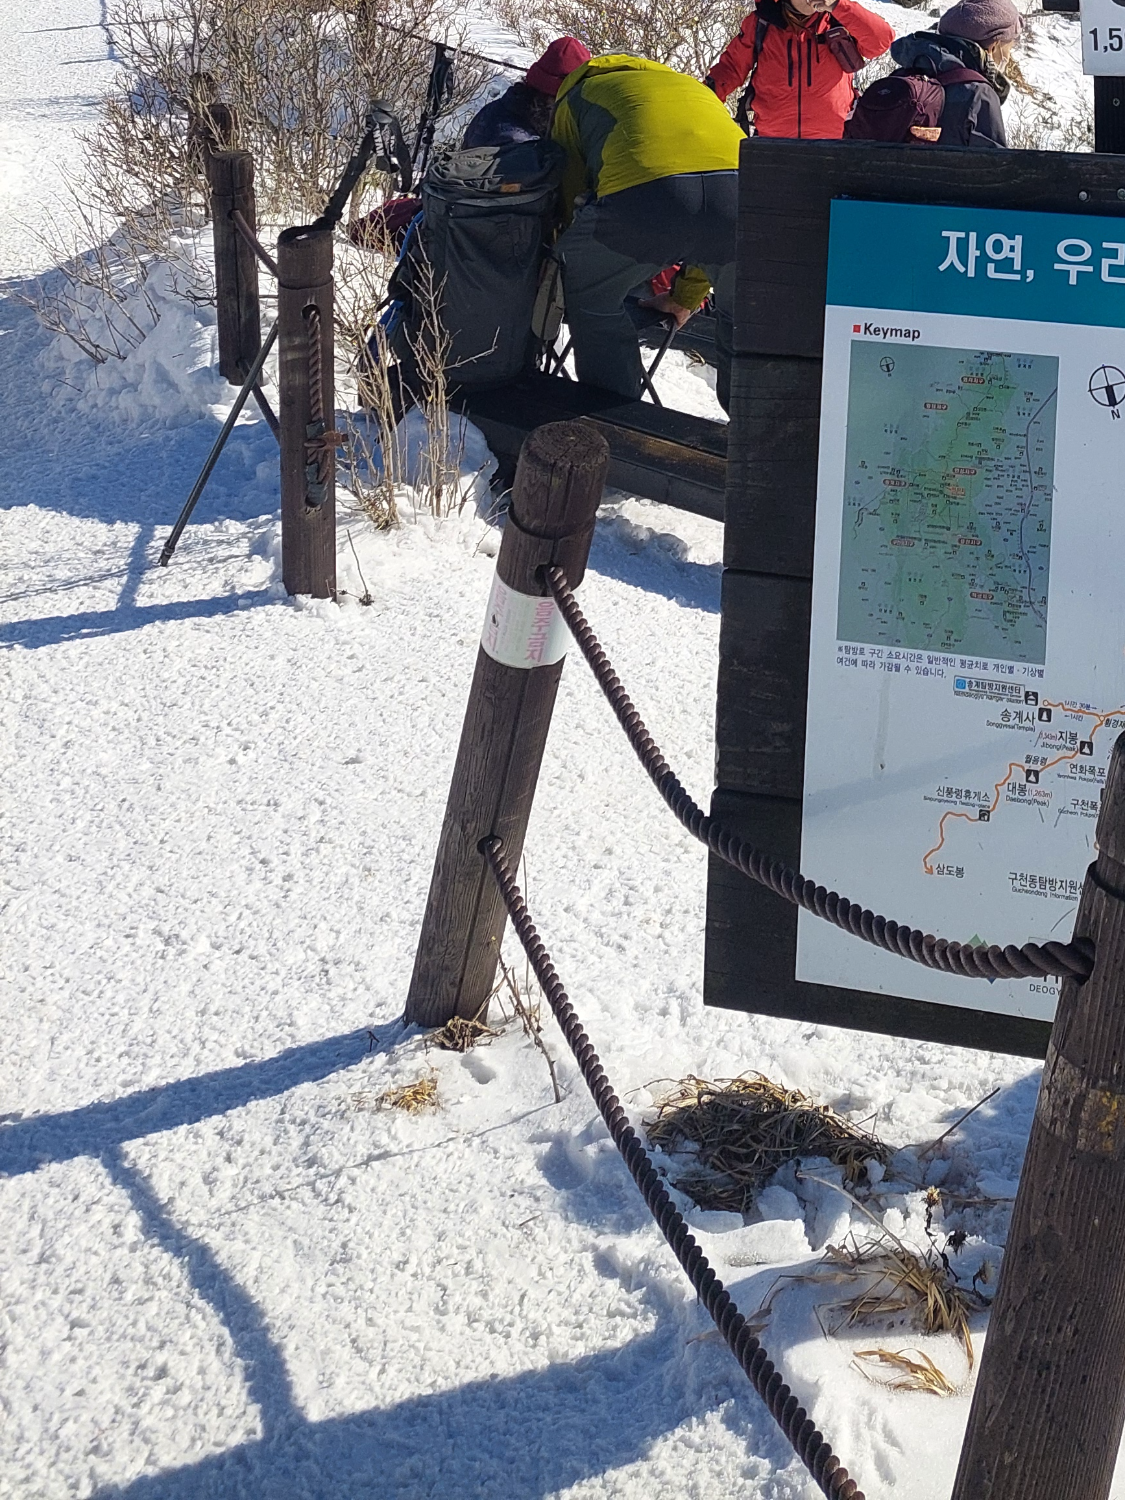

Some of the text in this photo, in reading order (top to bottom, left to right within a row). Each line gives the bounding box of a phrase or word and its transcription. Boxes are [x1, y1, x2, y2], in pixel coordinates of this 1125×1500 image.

[938, 230, 1036, 284] 자연,
[864, 323, 921, 341] Keymap
[869, 648, 883, 659] 구간
[887, 650, 924, 663] 소요시간은
[927, 654, 956, 667] 일반적인
[862, 659, 876, 670] 따라
[904, 666, 912, 674] 수
[1000, 707, 1036, 726] 송계사
[1058, 730, 1079, 746] 지봉
[1069, 763, 1106, 778] 연화폭포
[936, 785, 990, 803] 신풍령휴게소
[1007, 782, 1028, 798] 대봉
[1070, 798, 1100, 814] 구천폭
[936, 863, 965, 879] 삼도봉
